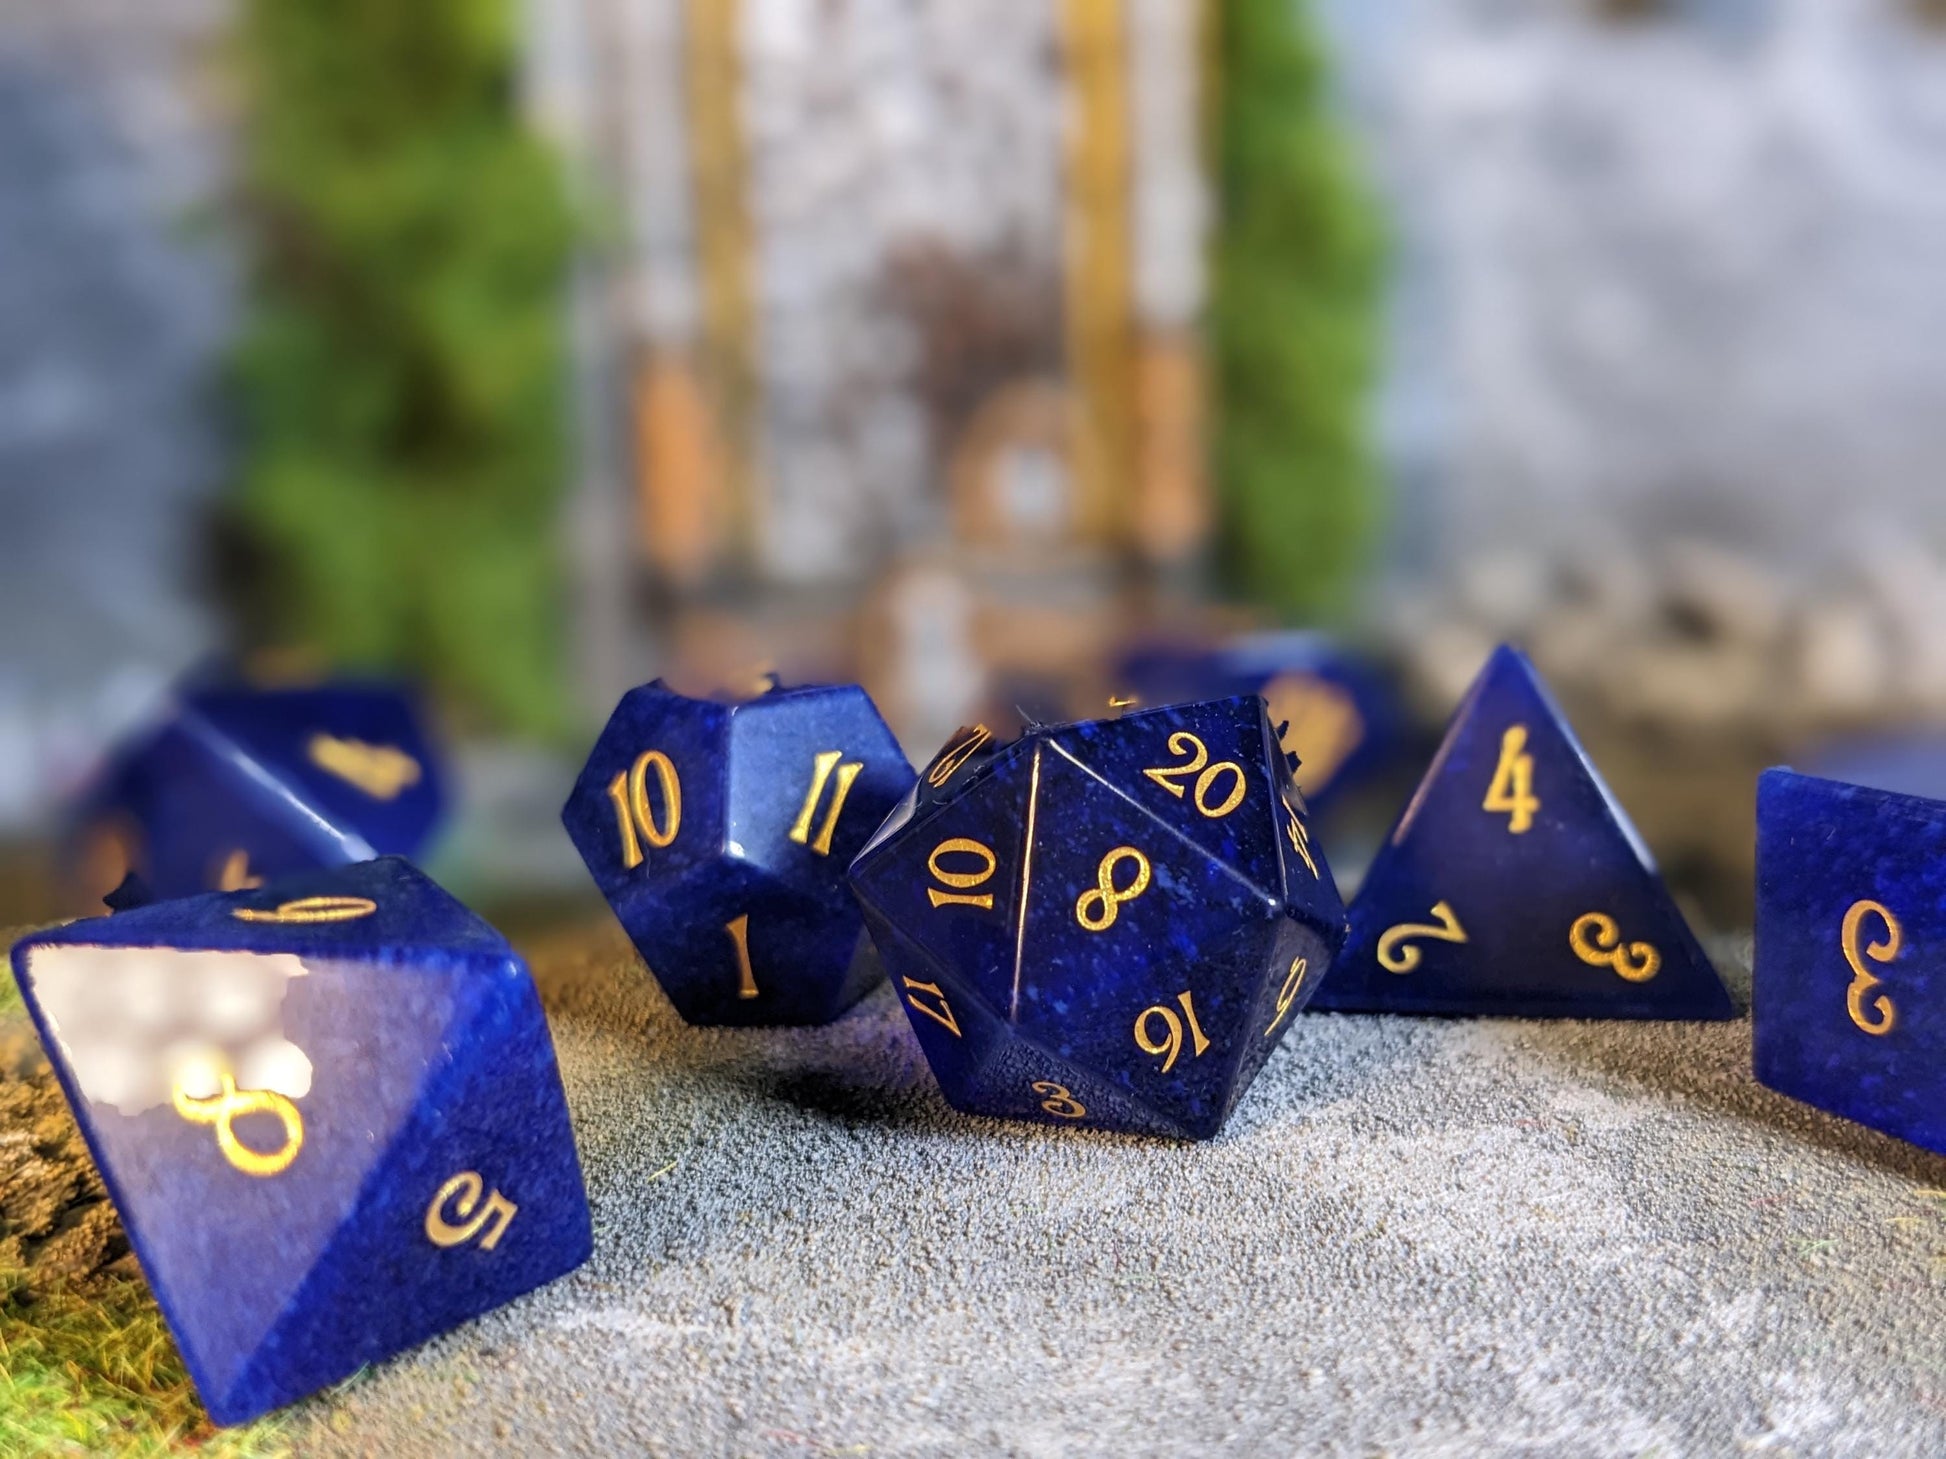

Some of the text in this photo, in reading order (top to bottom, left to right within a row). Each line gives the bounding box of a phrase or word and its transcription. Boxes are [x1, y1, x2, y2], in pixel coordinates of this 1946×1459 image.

[607, 749, 682, 869] 10
[789, 750, 864, 856] 11
[1143, 731, 1247, 818] 20
[1482, 724, 1541, 834] 4
[927, 838, 997, 910] 10
[1076, 846, 1152, 932] 8
[725, 913, 760, 999] 1
[1568, 911, 1661, 982] 3
[1841, 899, 1902, 1036] 3
[902, 975, 962, 1038] 17
[1133, 990, 1211, 1073] 16
[425, 1171, 518, 1250] 5
